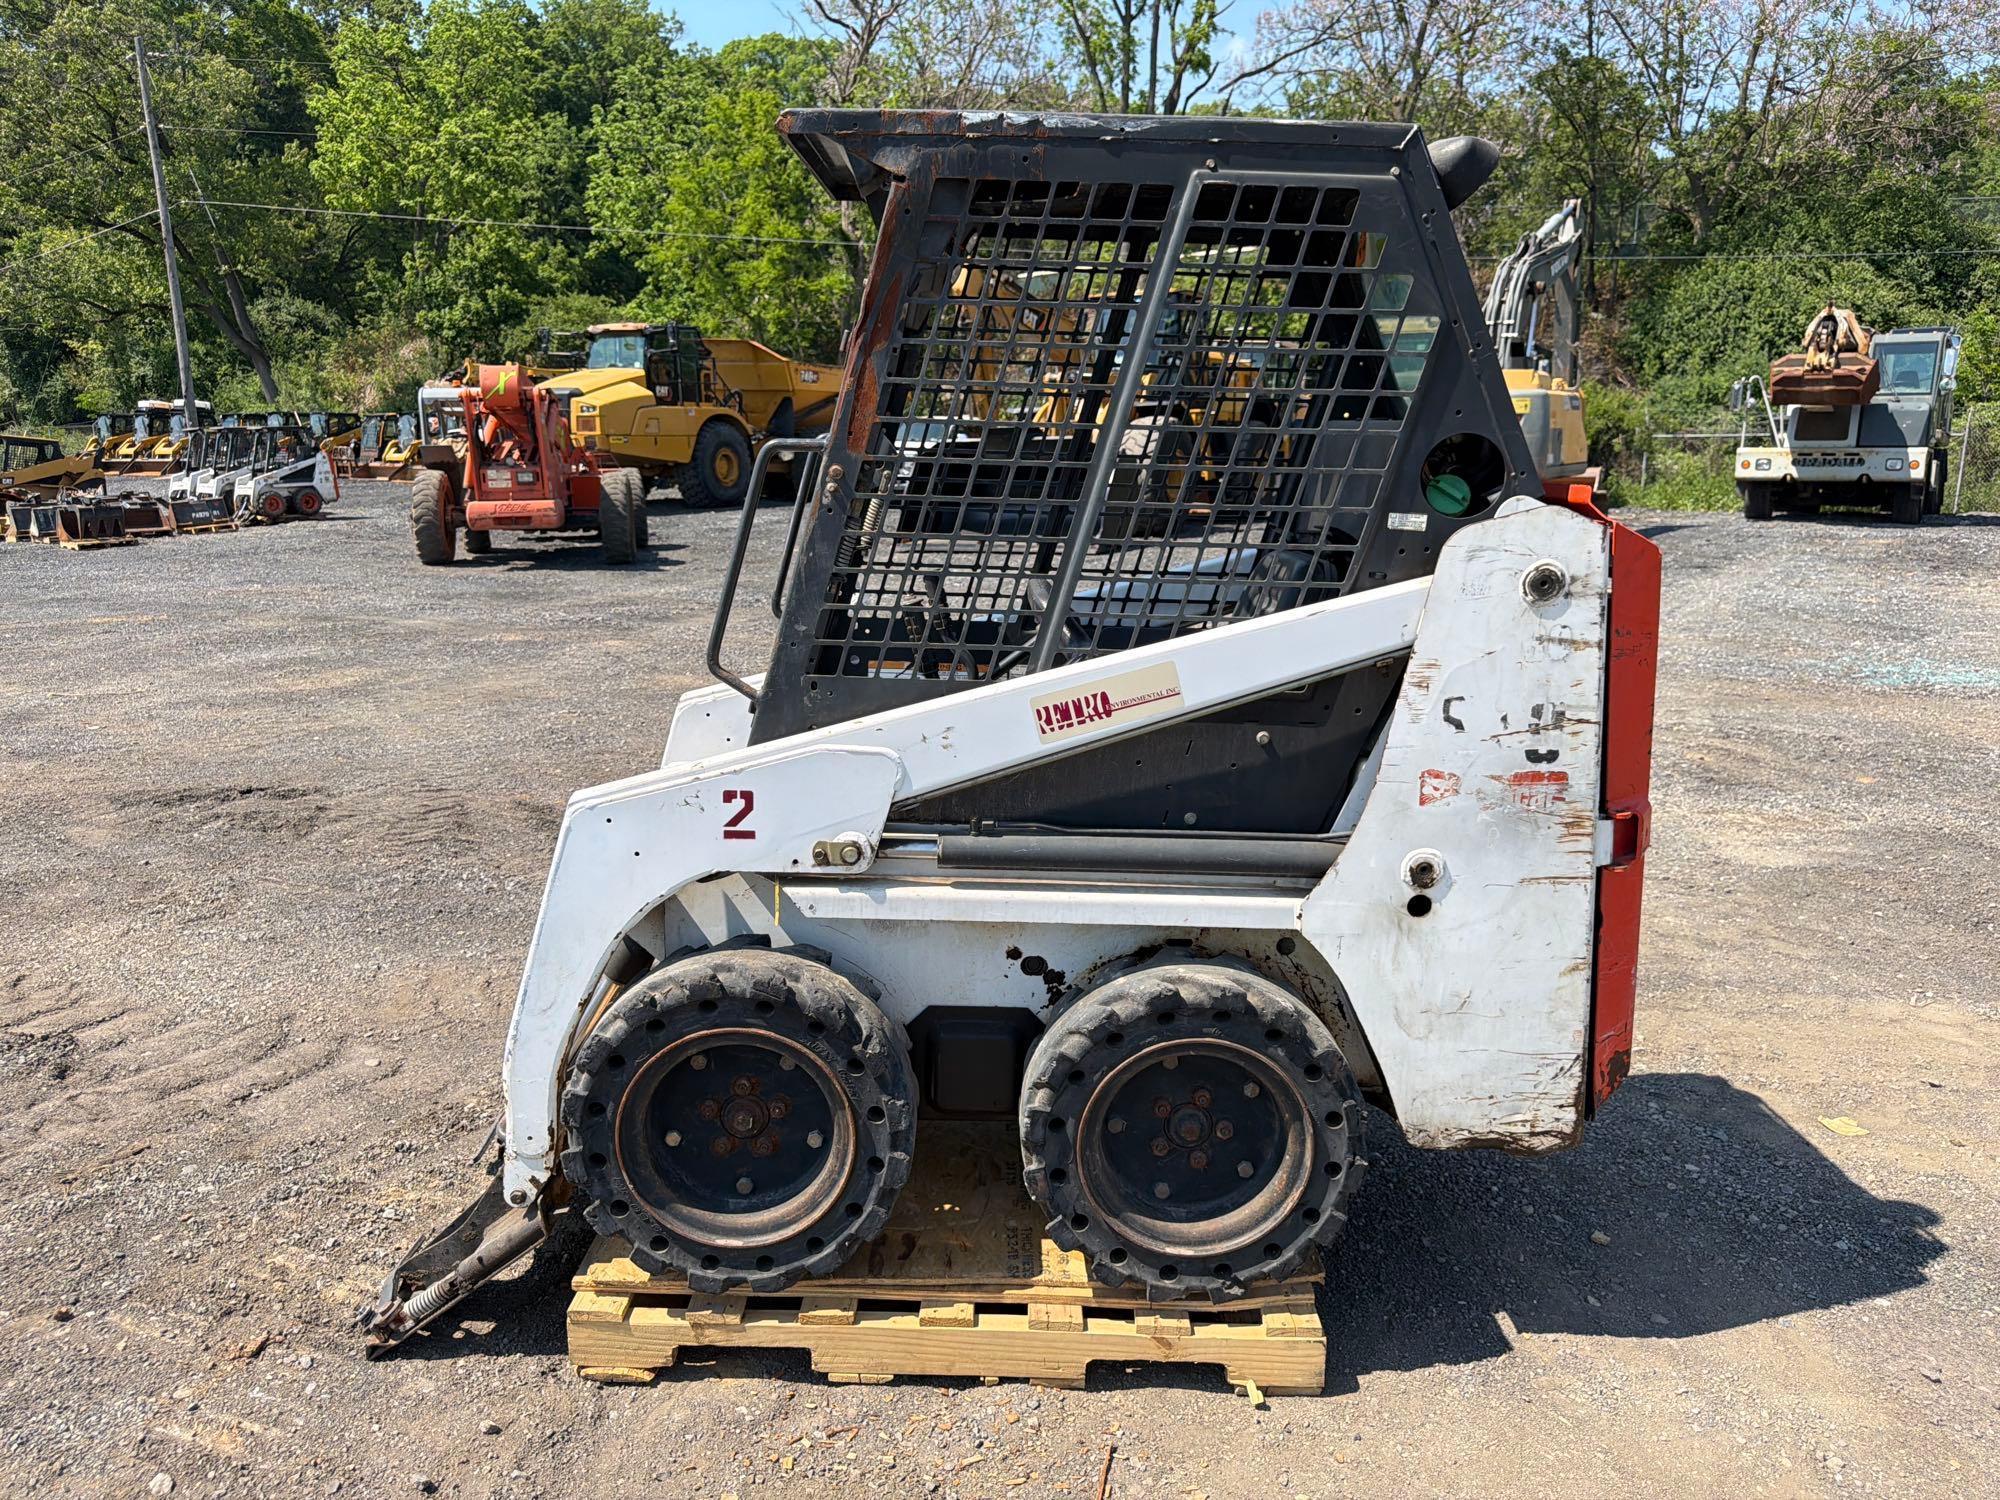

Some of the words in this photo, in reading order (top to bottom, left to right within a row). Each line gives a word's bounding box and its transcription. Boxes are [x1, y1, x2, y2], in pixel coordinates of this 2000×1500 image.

[655, 385, 669, 397] CAT
[2, 478, 14, 486] CAT
[1105, 691, 1164, 710] ENVIRONMENTAL
[722, 790, 756, 839] 2
